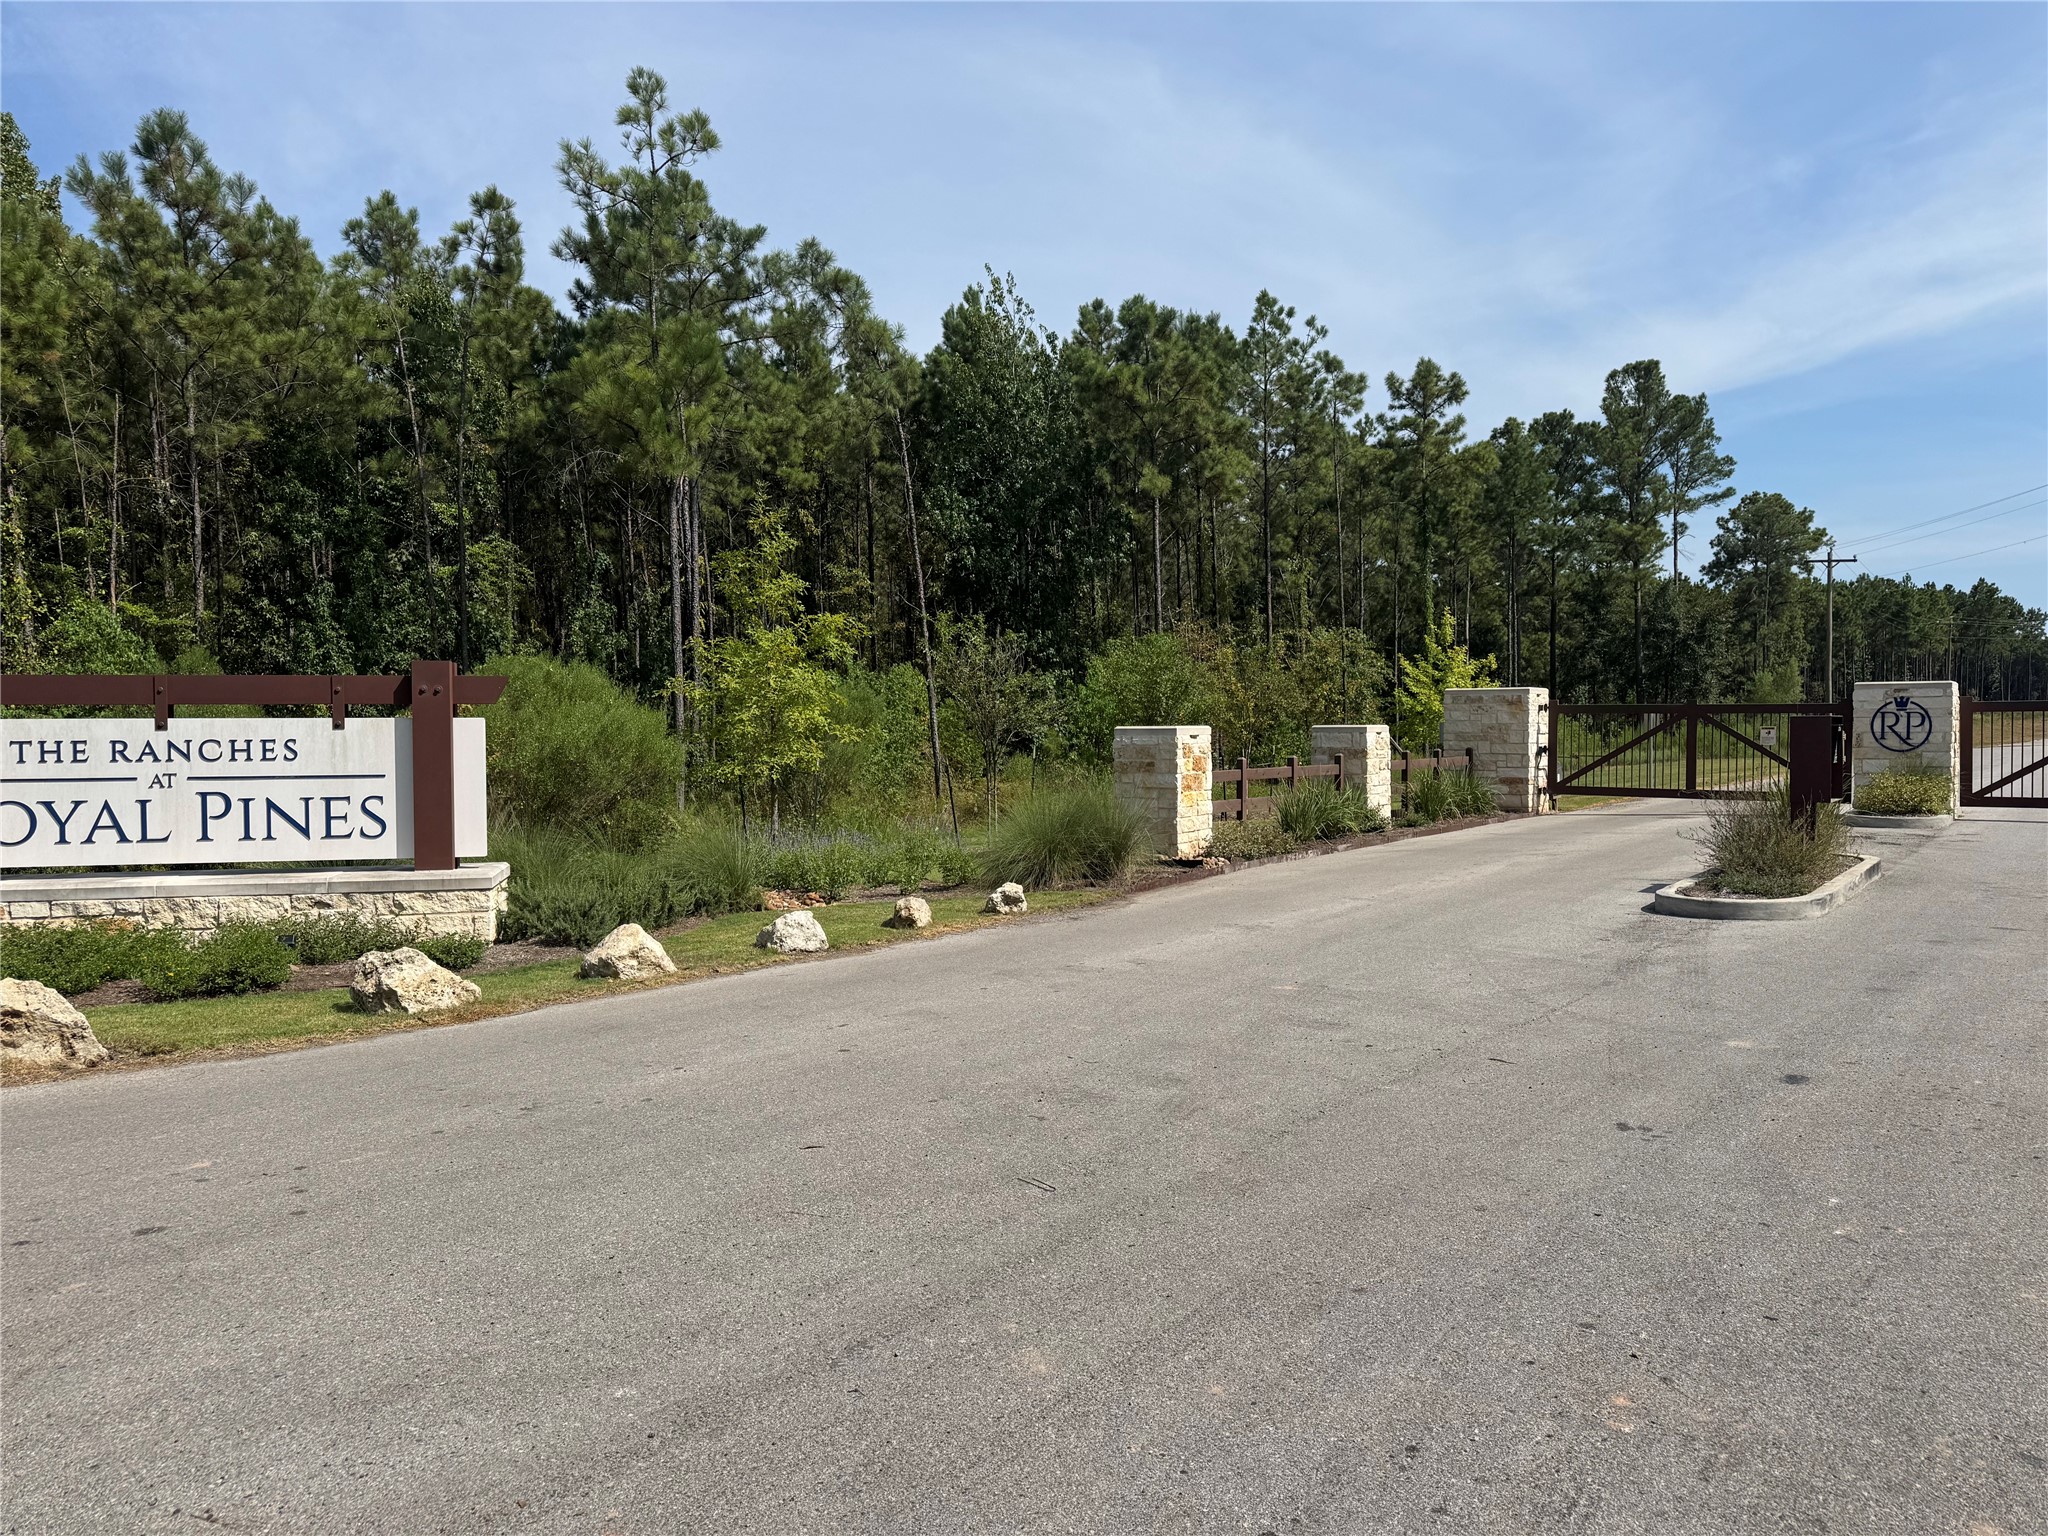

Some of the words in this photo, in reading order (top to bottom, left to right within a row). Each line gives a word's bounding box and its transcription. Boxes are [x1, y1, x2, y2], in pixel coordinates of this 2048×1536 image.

[1879, 711, 1926, 746] RP
[9, 740, 90, 764] THE
[109, 738, 299, 763] RANCHES
[148, 773, 177, 789] AT
[195, 791, 387, 842] PINES
